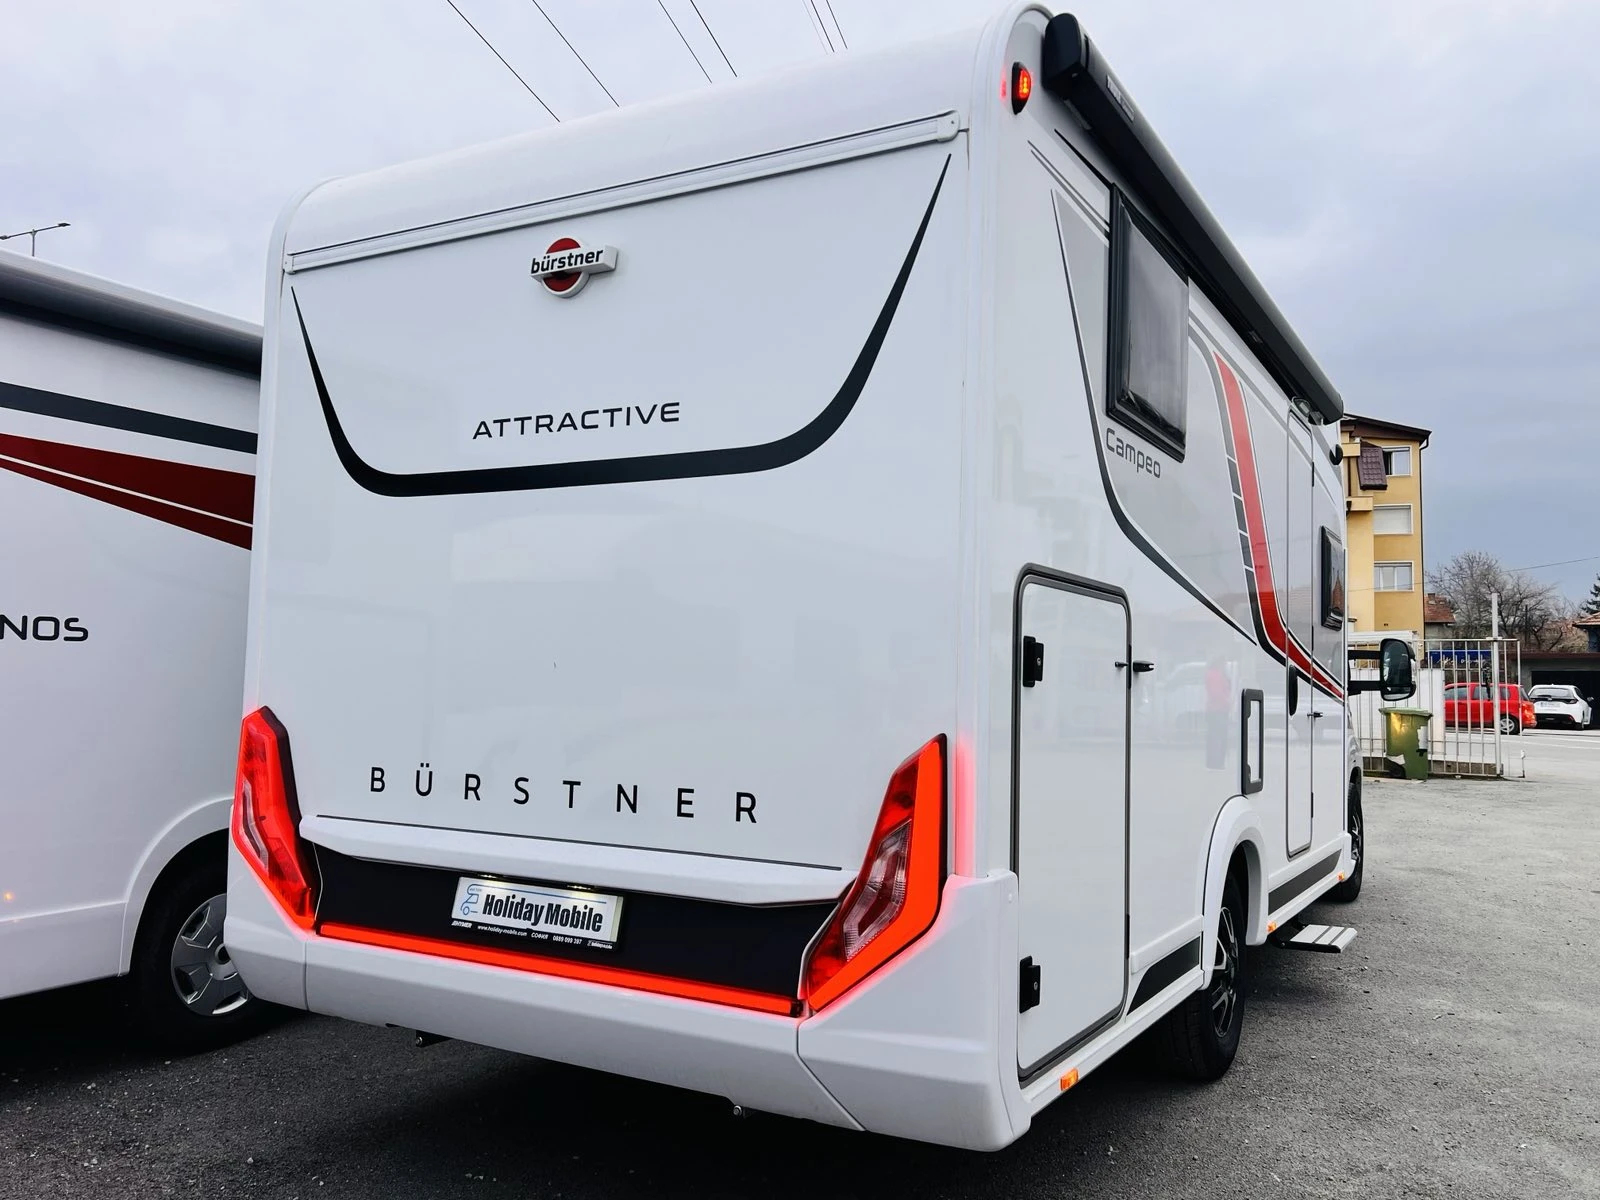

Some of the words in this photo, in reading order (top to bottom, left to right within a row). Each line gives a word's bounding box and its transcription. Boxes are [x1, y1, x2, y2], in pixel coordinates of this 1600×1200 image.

[530, 249, 604, 275] bürstner
[472, 401, 681, 441] ATTRACTIVE
[1106, 427, 1162, 479] Campeo
[0, 614, 89, 642] NOS
[370, 761, 758, 825] BÜRSTNER
[482, 893, 545, 927] Holiday
[544, 902, 604, 933] Mobile
